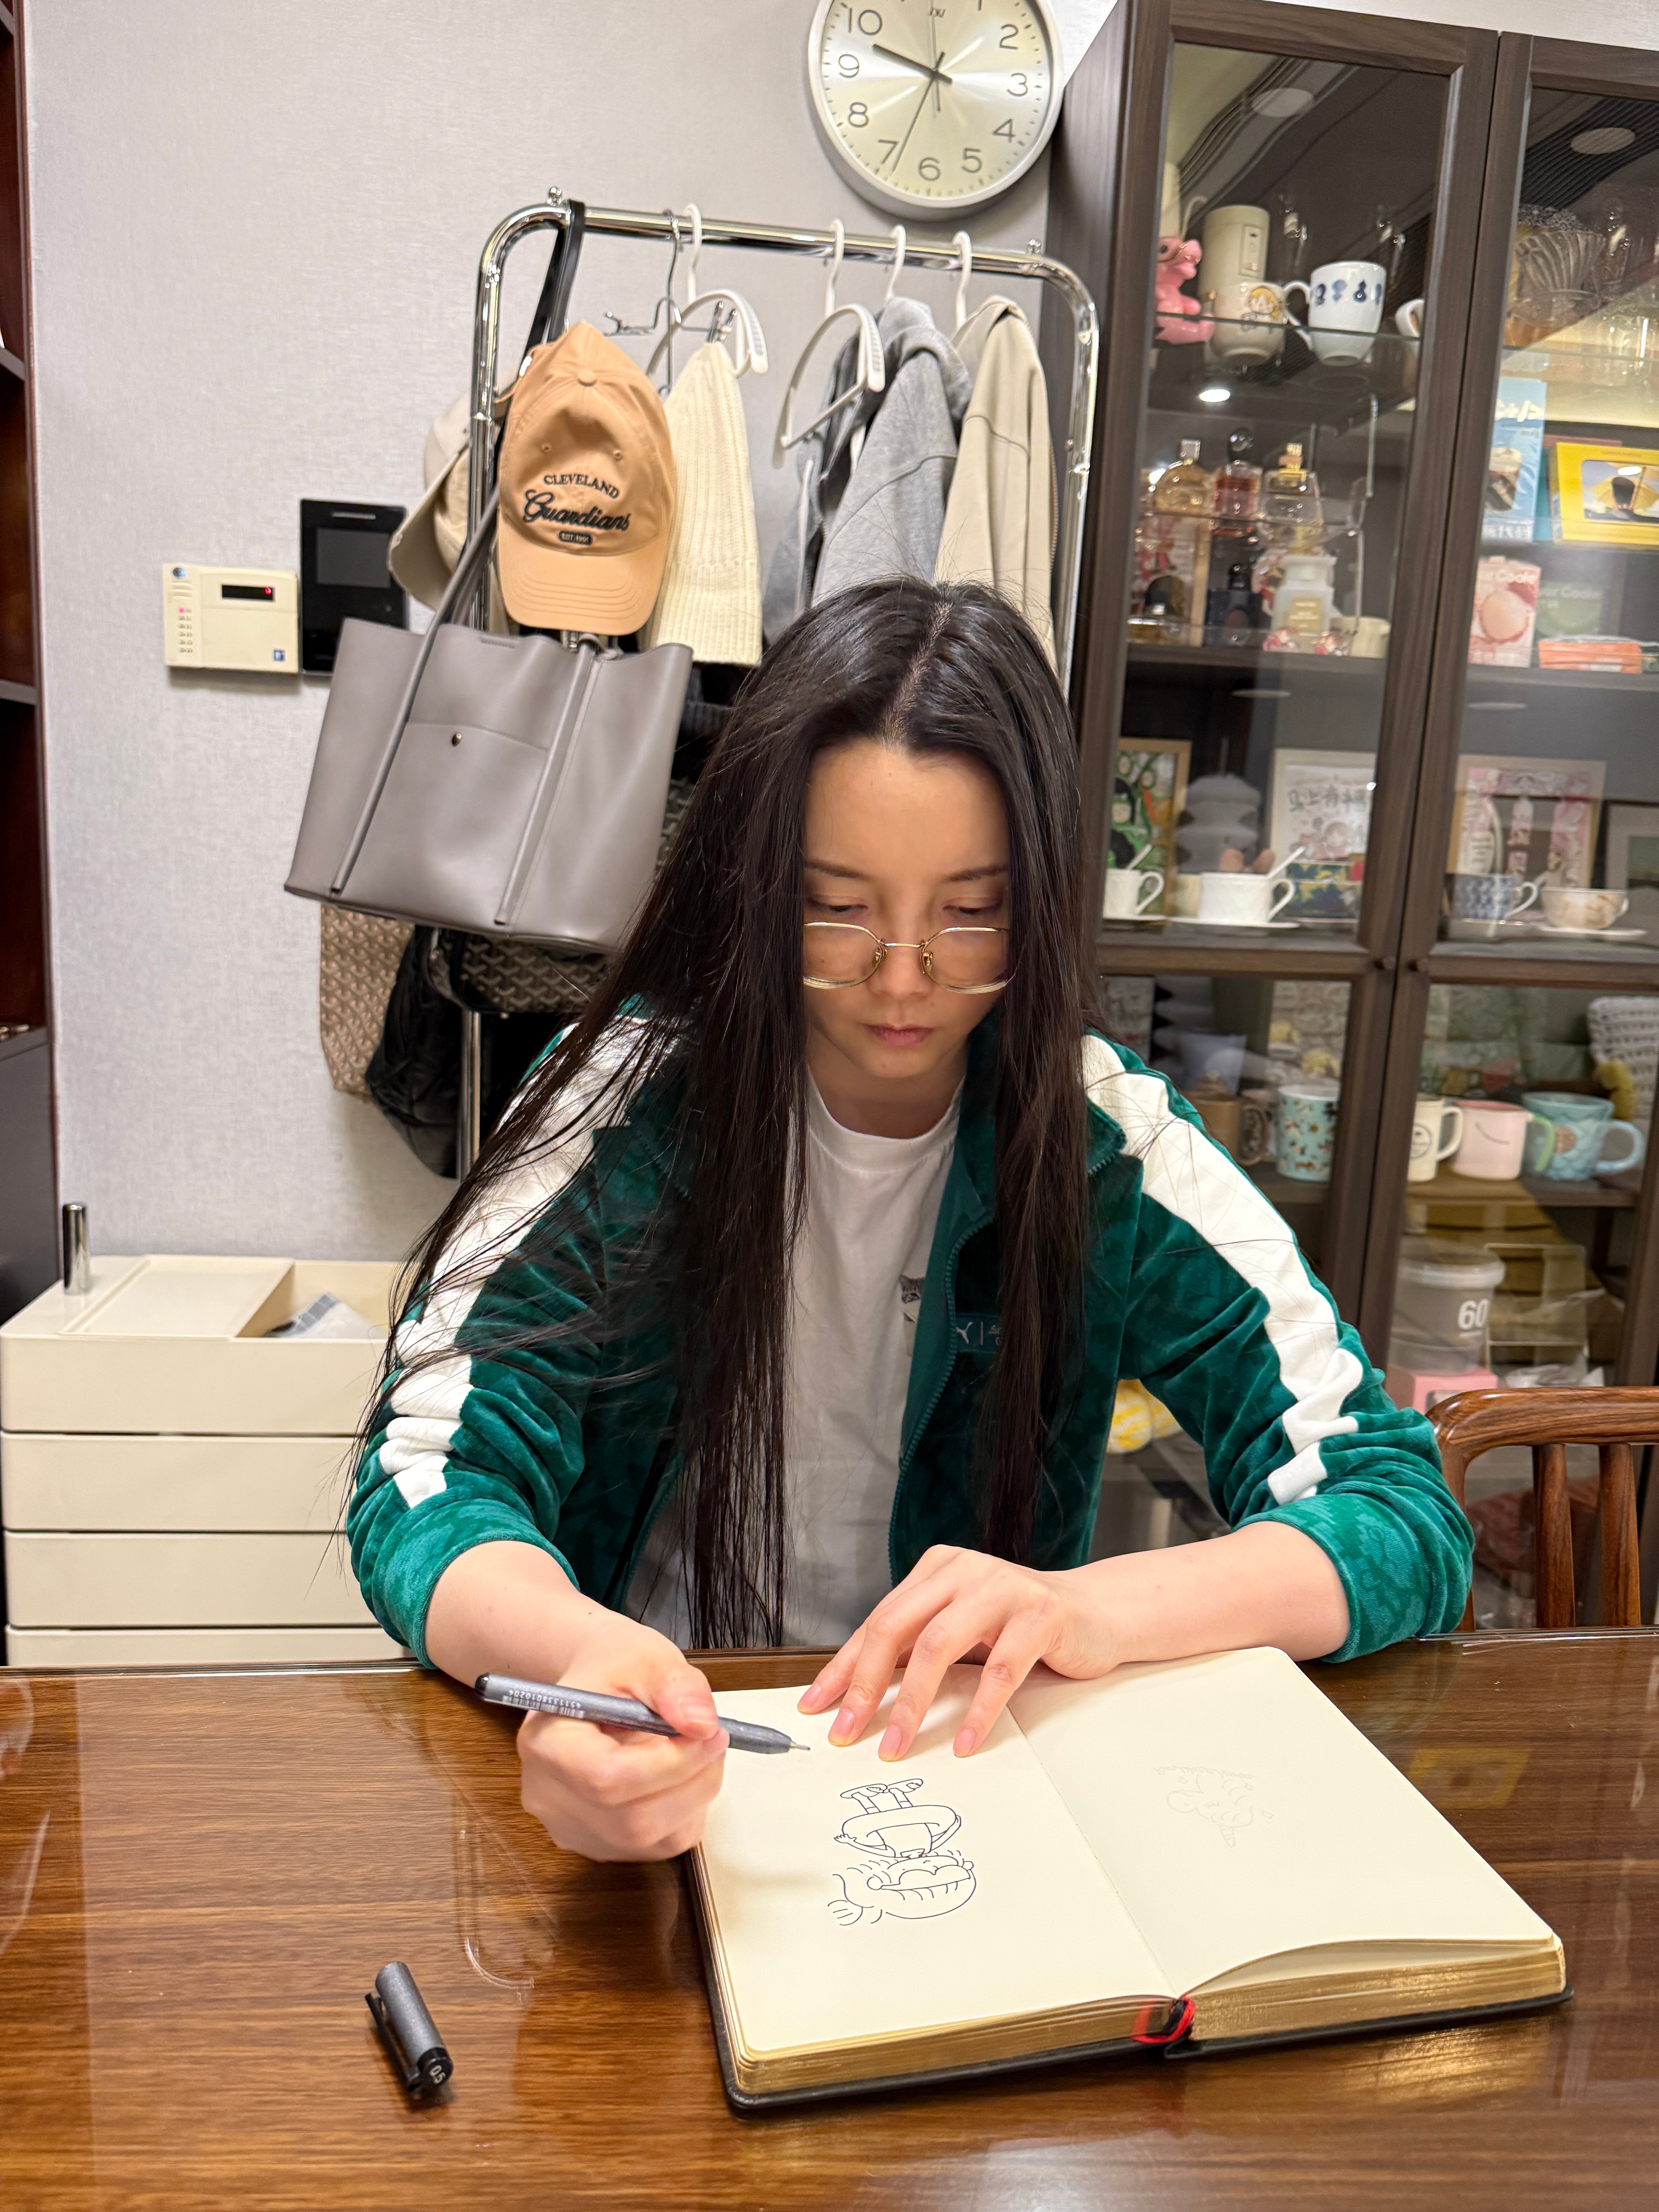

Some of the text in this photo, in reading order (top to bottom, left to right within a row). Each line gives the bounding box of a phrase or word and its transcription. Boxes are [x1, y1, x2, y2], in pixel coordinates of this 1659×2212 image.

[849, 8, 883, 35] 10
[1000, 24, 1019, 50] 2
[838, 54, 860, 78] 9
[1007, 73, 1028, 96] 3
[848, 102, 869, 128] 8
[992, 118, 1015, 143] 4
[878, 139, 899, 164] 7
[962, 148, 982, 173] 5
[918, 157, 941, 181] 6
[544, 474, 620, 499] CLEVELAND
[523, 489, 631, 532] Guardians
[1458, 1298, 1489, 1330] 60
[508, 1690, 581, 1709] 4511338010204
